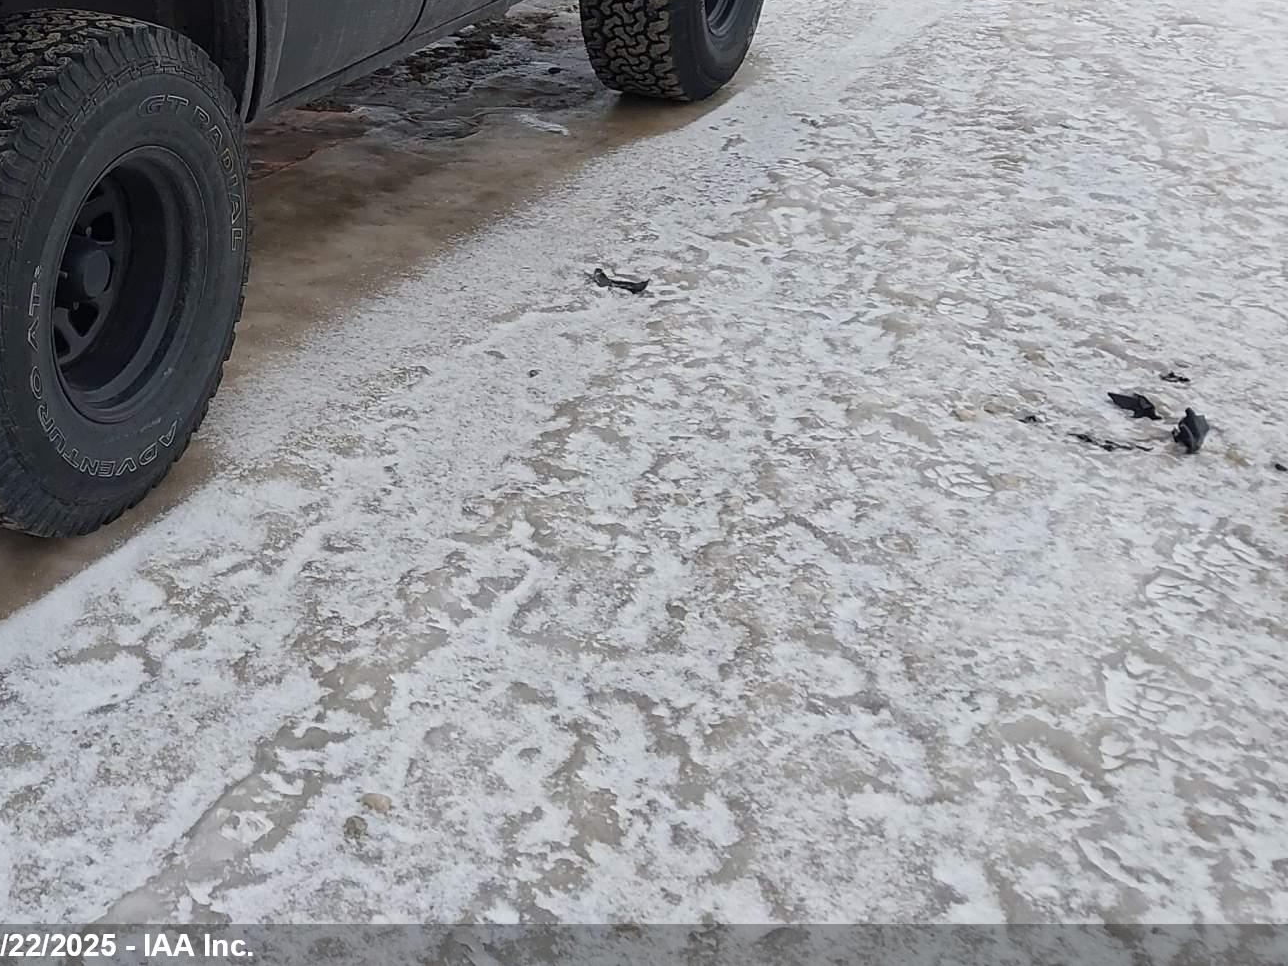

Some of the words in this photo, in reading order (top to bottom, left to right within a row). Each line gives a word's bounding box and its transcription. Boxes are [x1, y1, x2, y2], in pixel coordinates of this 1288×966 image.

[138, 94, 189, 117] GT
[192, 104, 243, 252] RADIAL
[29, 365, 179, 478] ADVENTURO
